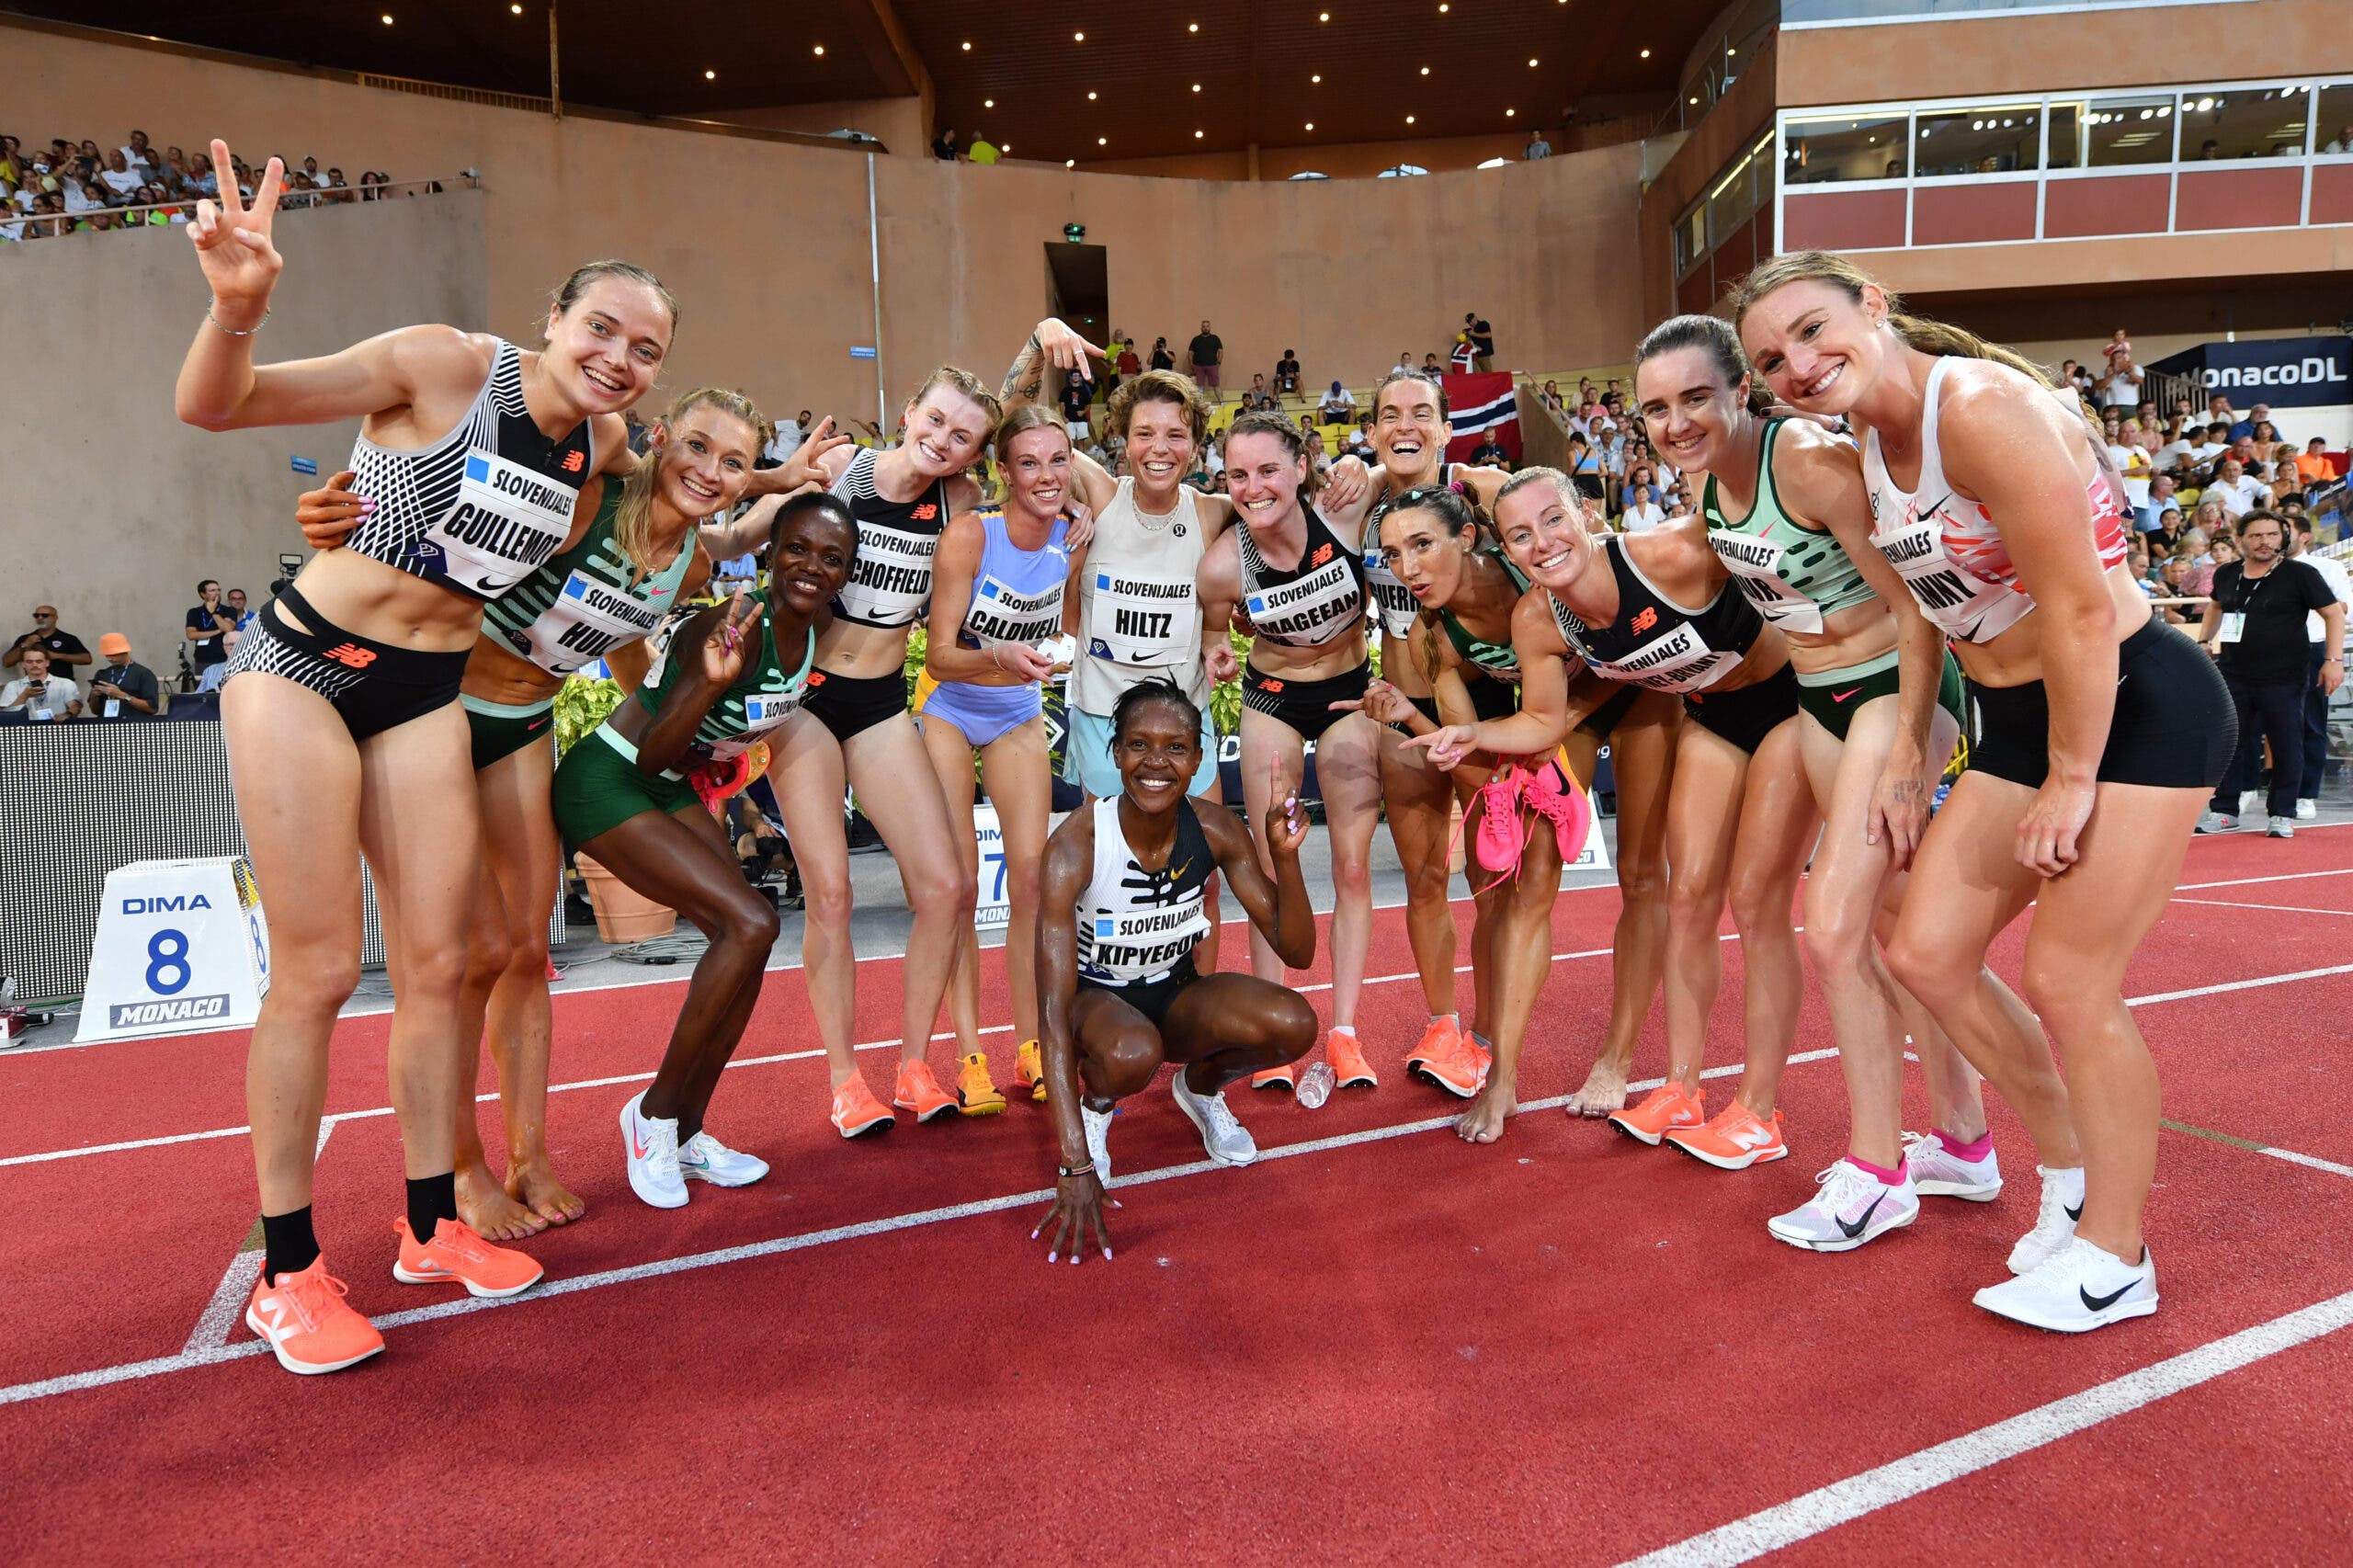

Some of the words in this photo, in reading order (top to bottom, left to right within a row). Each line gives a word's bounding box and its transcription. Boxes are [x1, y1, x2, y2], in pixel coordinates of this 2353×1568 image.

[493, 469, 573, 517] SLOVENIJALES
[443, 502, 563, 566] GUILLEMOT
[858, 529, 936, 557] SLOVENIJALES
[849, 557, 931, 595] CHOFFIELD
[1113, 579, 1192, 598] SLOVENIJALES
[1267, 565, 1345, 608] SLOVENIJALES
[999, 586, 1062, 613] SLOVENIJALES
[1258, 590, 1358, 634] MAGEEAN
[557, 621, 621, 656] HULL
[969, 610, 1061, 642] CALDWELL
[1115, 608, 1173, 638] HILTZ
[984, 853, 1008, 902] 7
[122, 894, 212, 915] DIMA
[974, 907, 1011, 924] MON
[1120, 901, 1202, 936] SLOVENIJALES
[145, 928, 191, 995] 8
[1097, 929, 1204, 966] KIPYEGON
[117, 997, 223, 1026] MONACO
